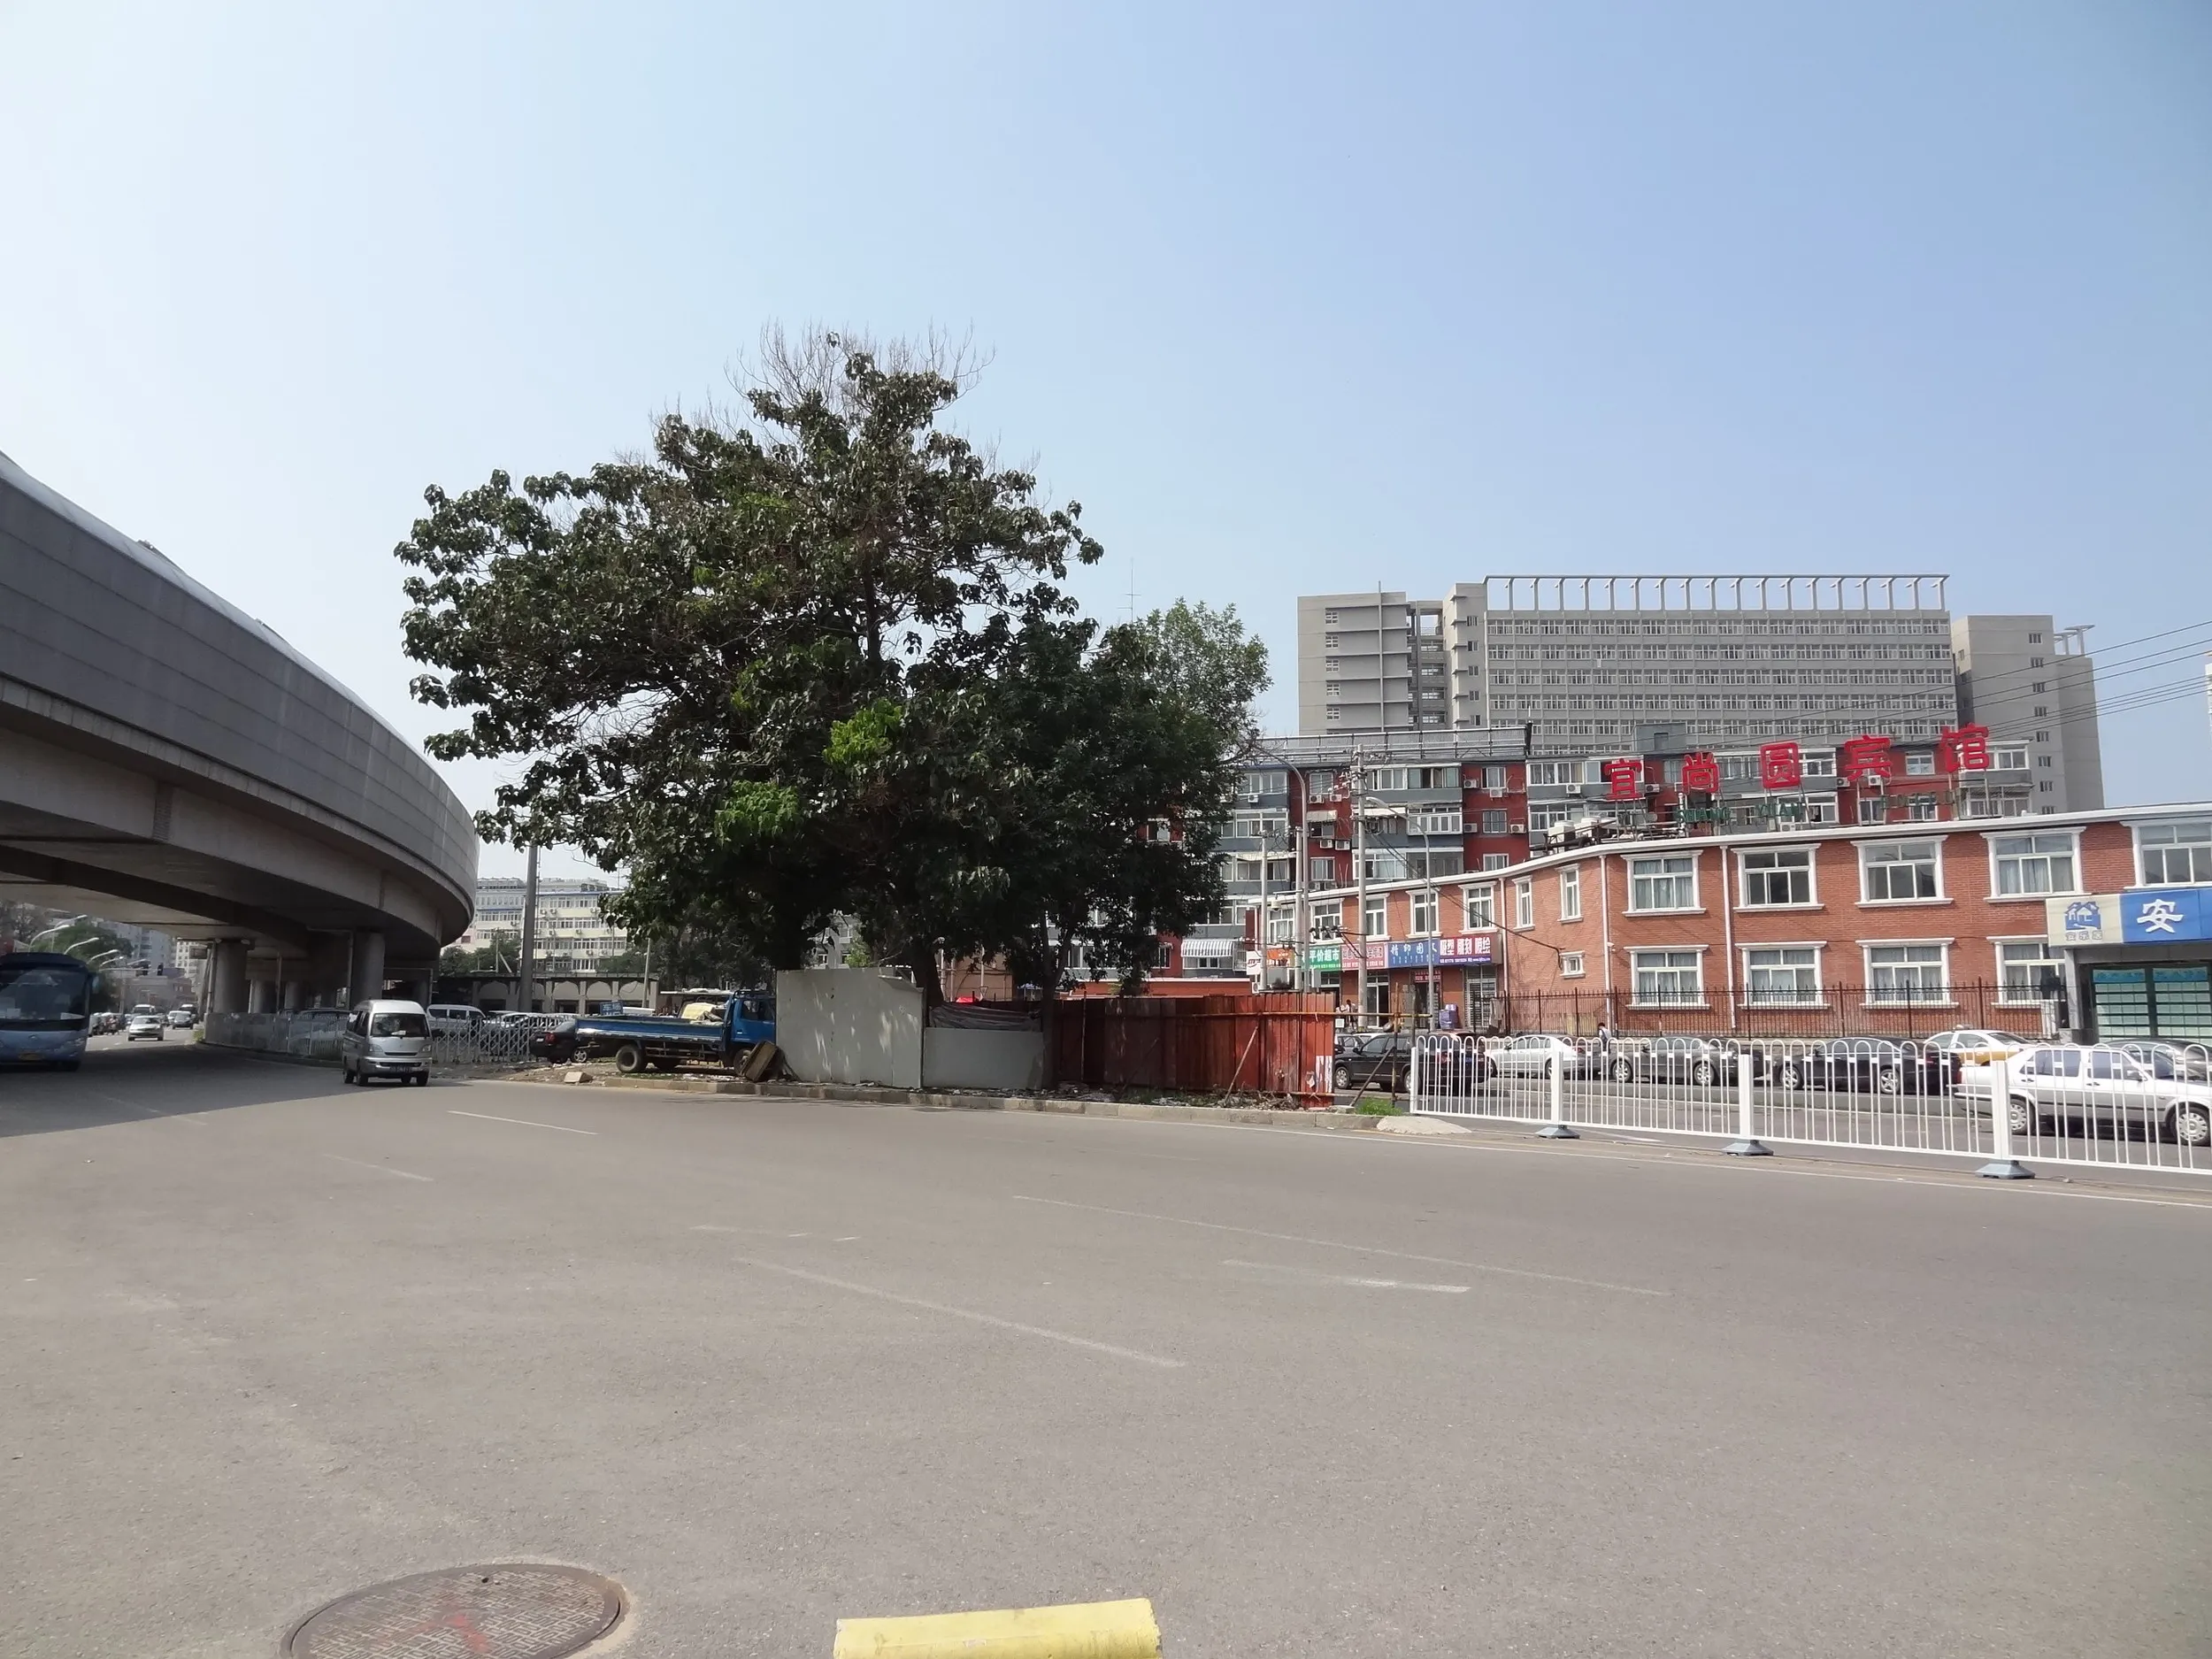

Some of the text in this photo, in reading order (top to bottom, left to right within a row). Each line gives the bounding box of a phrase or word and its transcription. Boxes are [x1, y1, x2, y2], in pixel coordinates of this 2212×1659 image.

[1604, 723, 1990, 801] 宜尚圆宾馆
[1675, 807, 1731, 824] SHANG
[2136, 898, 2184, 933] 安
[1302, 948, 1340, 963] 平价超市
